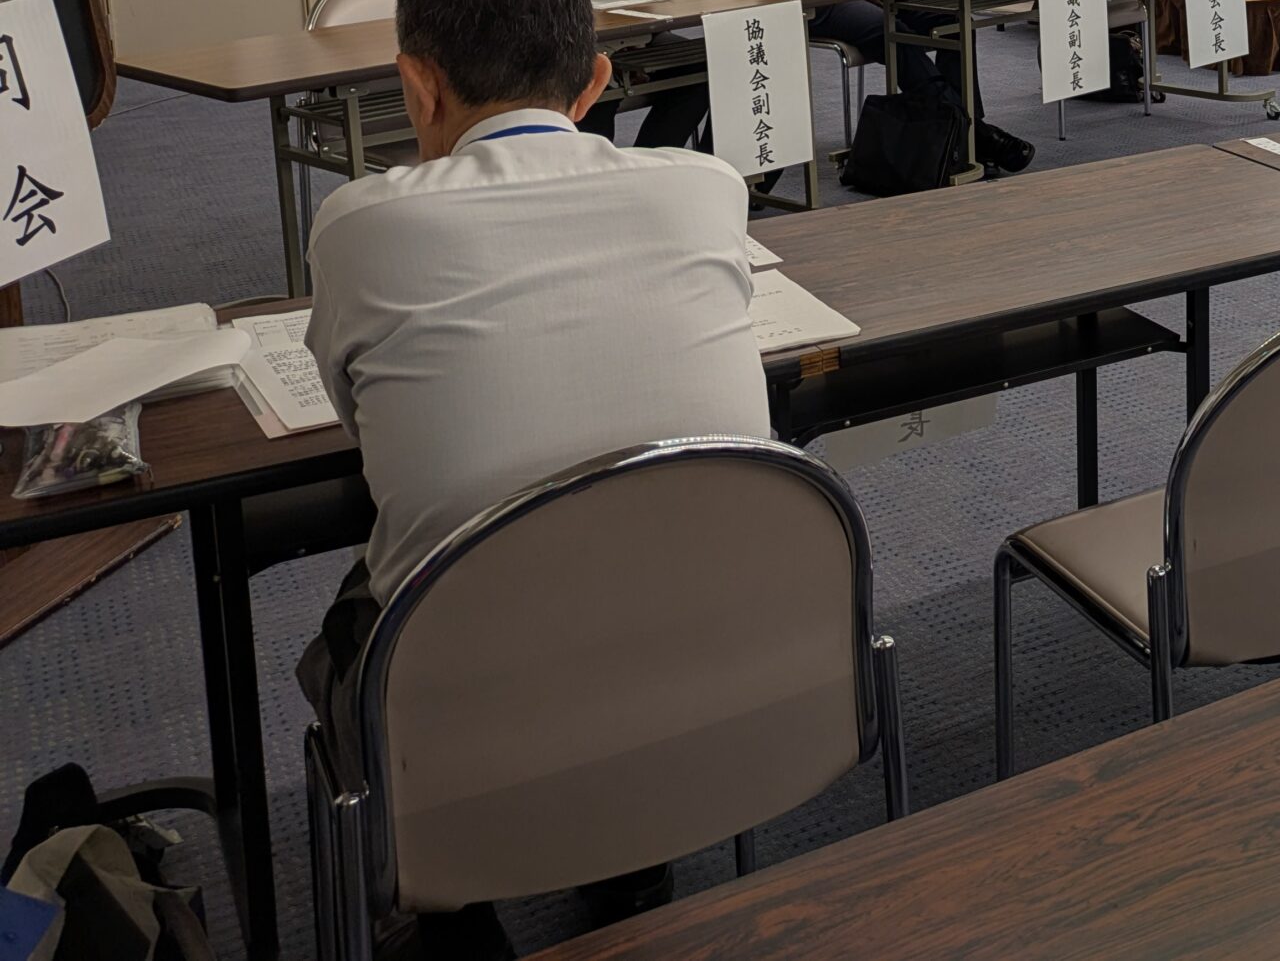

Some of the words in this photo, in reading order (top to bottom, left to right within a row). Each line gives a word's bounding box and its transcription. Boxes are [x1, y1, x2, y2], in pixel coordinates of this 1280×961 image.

[744, 18, 776, 167] 協議会副会長
